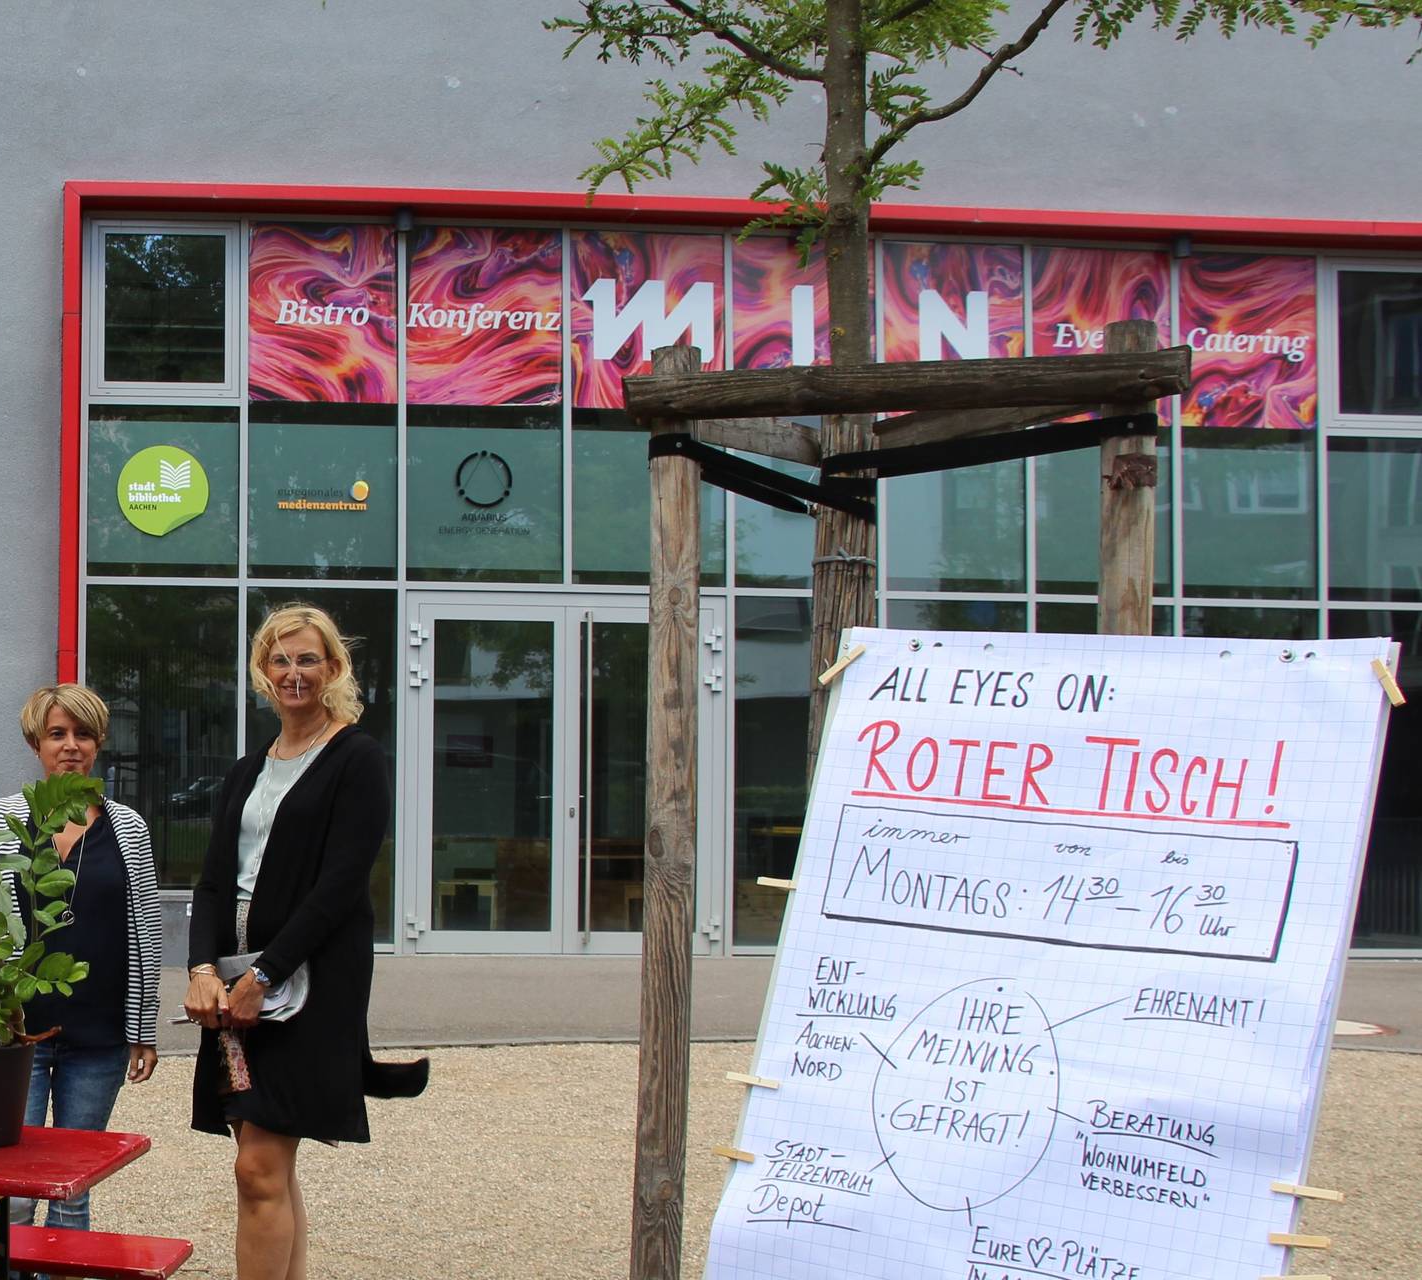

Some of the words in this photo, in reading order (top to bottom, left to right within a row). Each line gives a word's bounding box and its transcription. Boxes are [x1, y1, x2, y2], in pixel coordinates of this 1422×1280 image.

[275, 299, 369, 326] Bistro
[406, 302, 562, 336] Konferenz
[1053, 322, 1105, 348] Eve
[1187, 327, 1309, 362] Catering
[128, 481, 156, 492] stadt
[128, 492, 182, 503] bibliothek
[277, 487, 344, 499] euregionales
[128, 503, 158, 511] AACHEN
[277, 499, 367, 511] medienzentrum
[461, 512, 507, 522] AQUARIUS
[869, 667, 929, 703] ALL
[949, 669, 1034, 708] EYES
[1057, 673, 1116, 713] ON:
[857, 720, 1054, 806] ROTER
[1085, 735, 1286, 820] TISCH!
[861, 818, 971, 844] immer
[1054, 843, 1092, 857] von
[1160, 850, 1190, 866] bis
[843, 845, 1028, 919] MONTAGS:
[1198, 914, 1237, 938] Uhr
[815, 955, 866, 985] ENT-
[808, 986, 898, 1019] WICKLUNG
[957, 997, 1025, 1035] IHRE
[1133, 988, 1267, 1034] EHRENAMT!
[791, 1051, 843, 1081] NORD
[907, 1029, 1042, 1076] MEINUNG
[944, 1076, 987, 1103] IST
[889, 1098, 1031, 1148] GEFRAGT!
[1086, 1099, 1216, 1147] BERATUNG
[765, 1160, 874, 1193] TEILZENTRUM
[747, 1183, 826, 1229] Depot
[971, 1225, 1022, 1263] EURE
